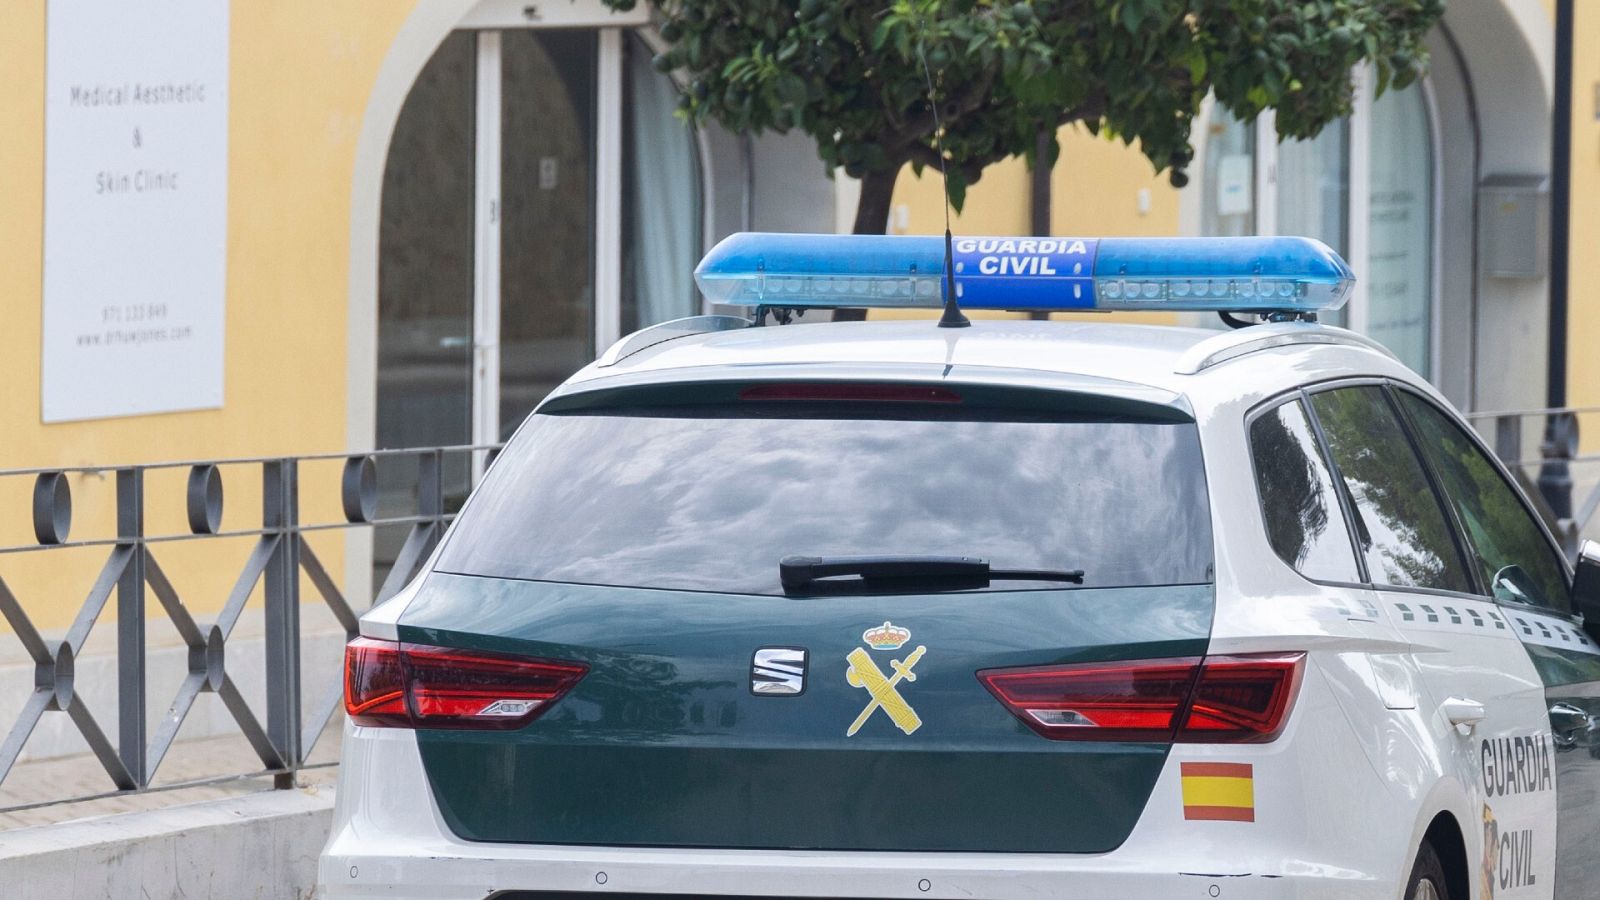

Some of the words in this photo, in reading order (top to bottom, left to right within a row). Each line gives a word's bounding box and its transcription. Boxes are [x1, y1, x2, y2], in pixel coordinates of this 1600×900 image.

[70, 83, 129, 107] Medical
[133, 80, 205, 104] Aesthetic
[132, 126, 142, 148] &
[96, 171, 130, 194] Skin
[134, 169, 178, 192] Clinic
[956, 239, 1087, 254] GUARDIA
[979, 256, 1056, 275] CIVIL
[1481, 735, 1552, 797] GUARDIA
[1500, 829, 1536, 890] CIVIL
